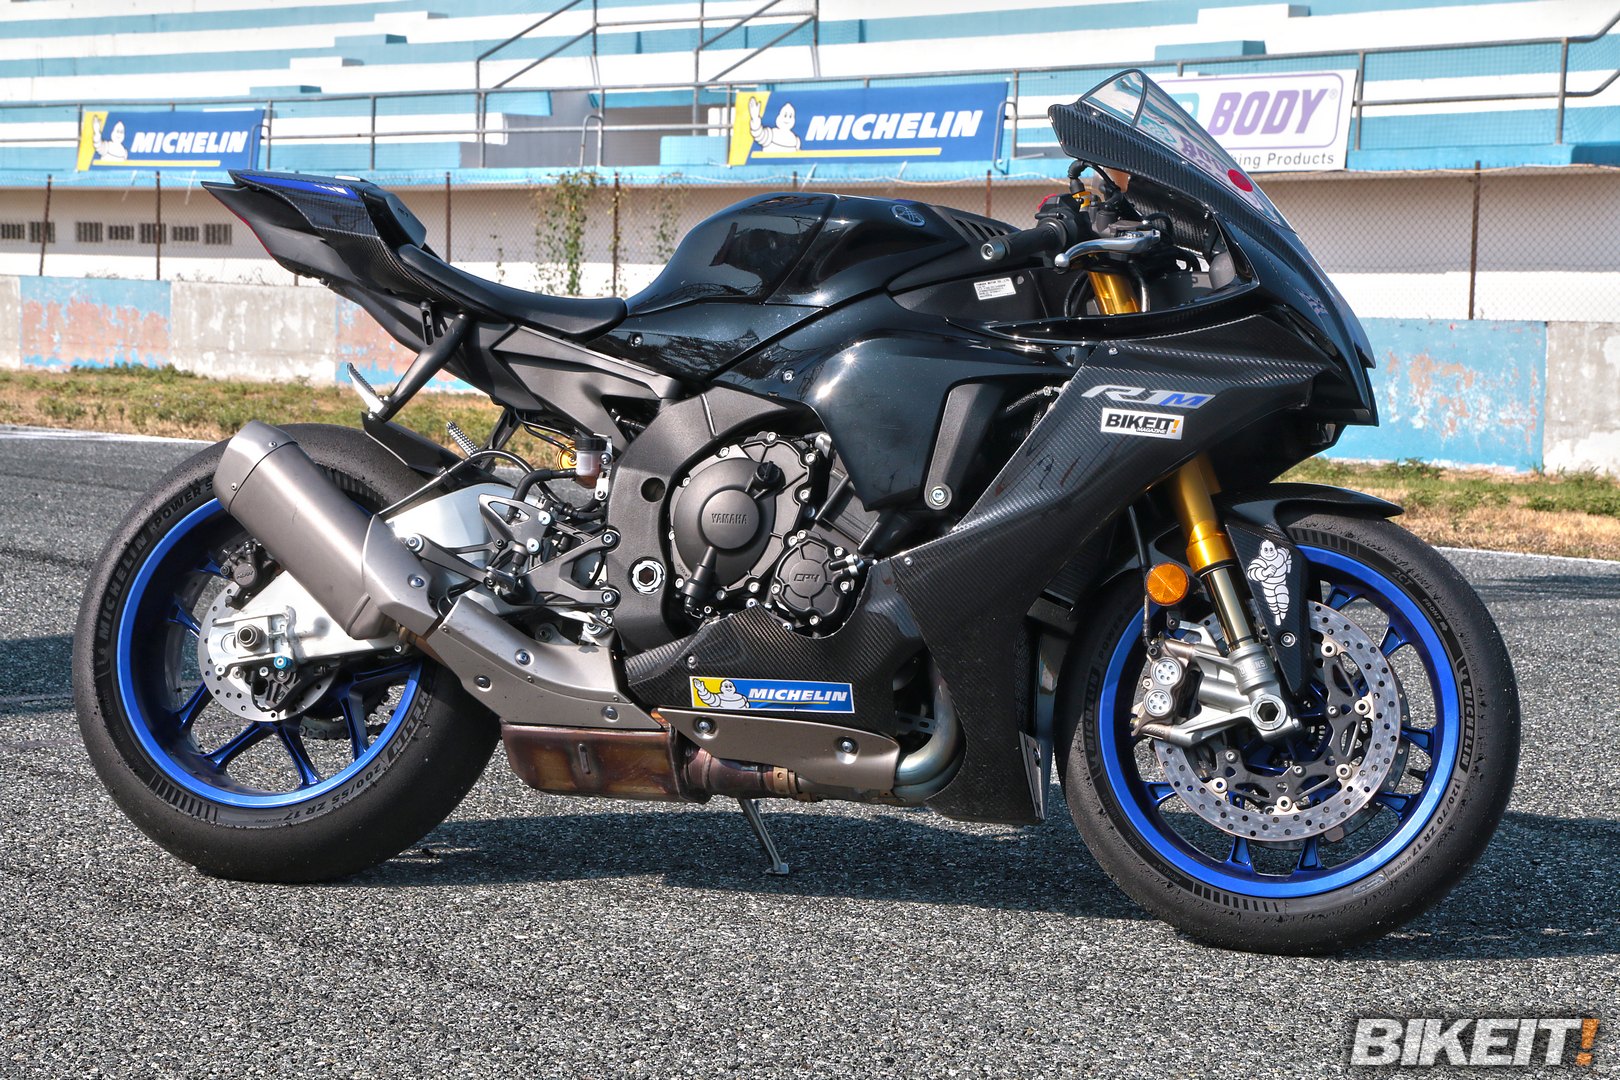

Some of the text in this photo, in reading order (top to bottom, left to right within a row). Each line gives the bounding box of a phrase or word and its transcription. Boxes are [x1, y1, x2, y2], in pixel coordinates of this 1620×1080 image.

[1208, 88, 1329, 136] BODY
[805, 110, 983, 141] MICHELIN
[131, 130, 248, 154] MICHELIN
[1231, 152, 1334, 169] ing Products
[1081, 384, 1216, 410] R1M
[1105, 413, 1180, 434] BIKEIT!
[711, 513, 748, 525] YAMAHA
[99, 486, 202, 640] MICHELIN POWER
[1422, 598, 1442, 620] FRONT
[748, 688, 848, 702] MICHELIN
[1462, 685, 1475, 767] MICHELIN
[284, 763, 381, 820] 200/55 ZR 17
[1437, 783, 1461, 825] 120/70
[1424, 826, 1437, 842] ZR
[1411, 843, 1423, 857] 17
